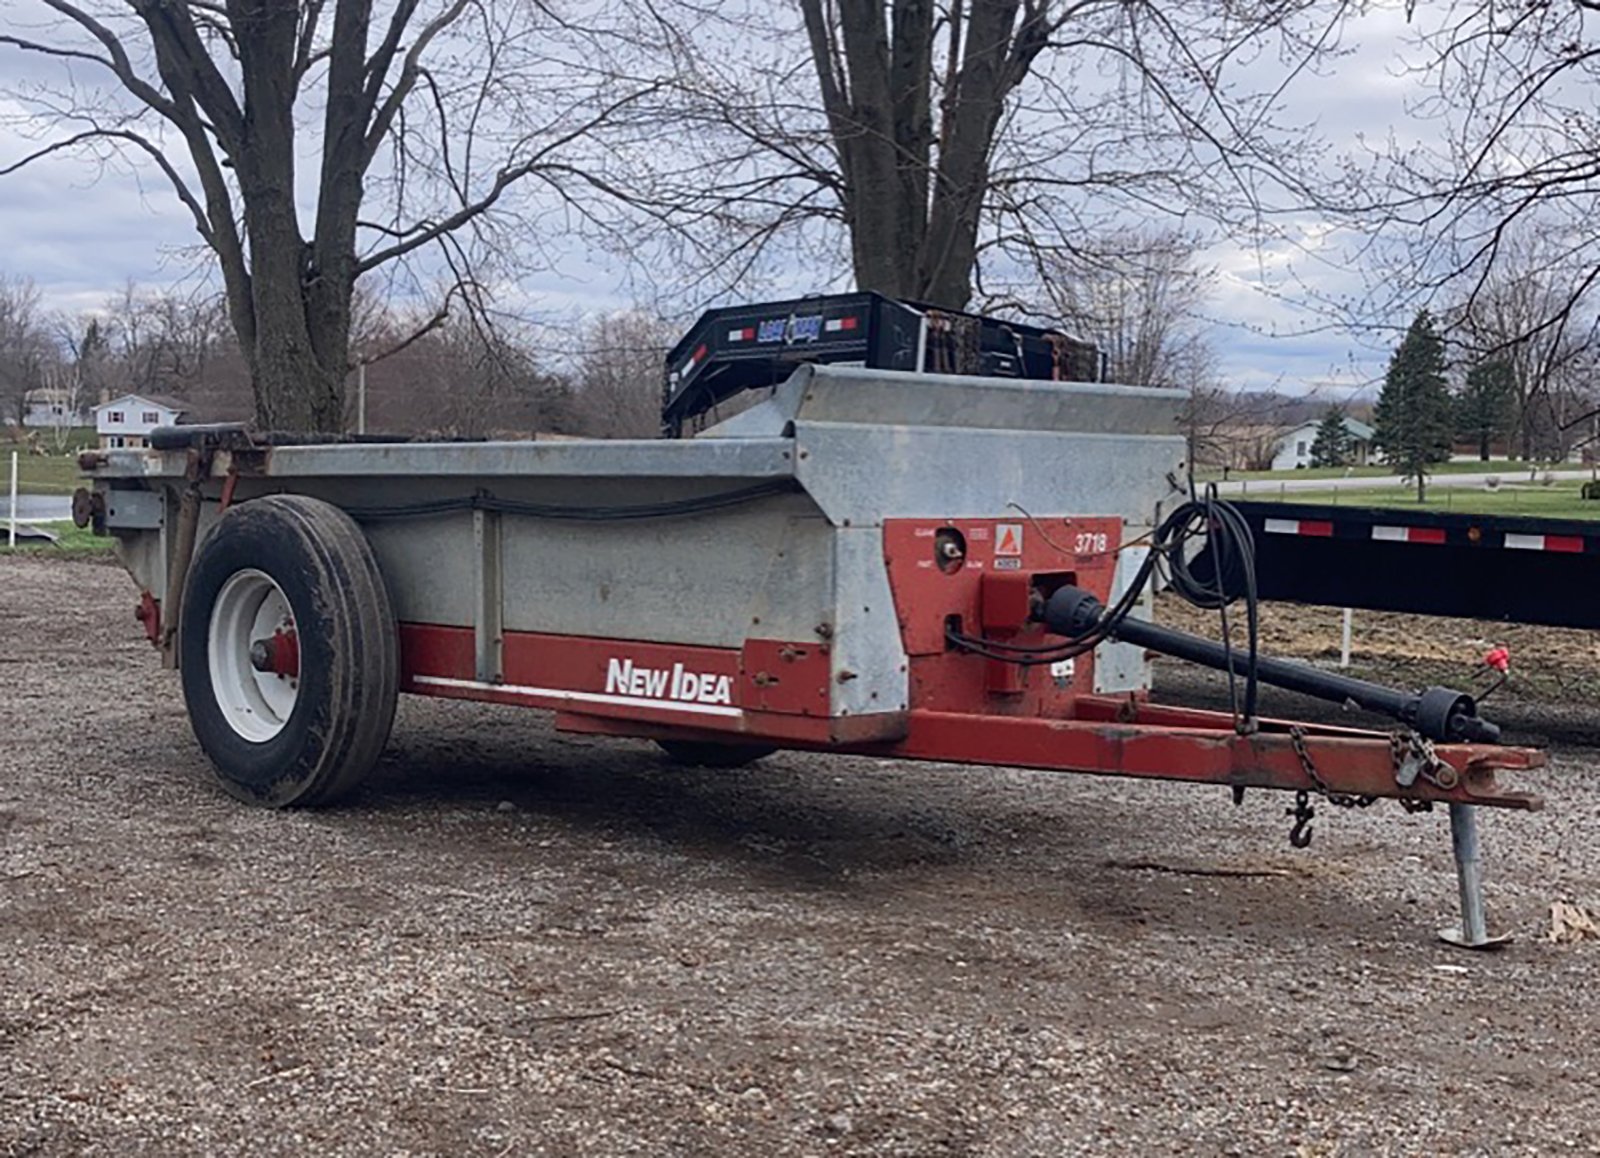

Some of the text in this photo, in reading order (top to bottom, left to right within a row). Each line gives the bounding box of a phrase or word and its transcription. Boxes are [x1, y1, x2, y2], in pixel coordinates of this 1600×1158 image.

[1074, 533, 1106, 553] 3718
[605, 657, 731, 704] NEW IDEA
